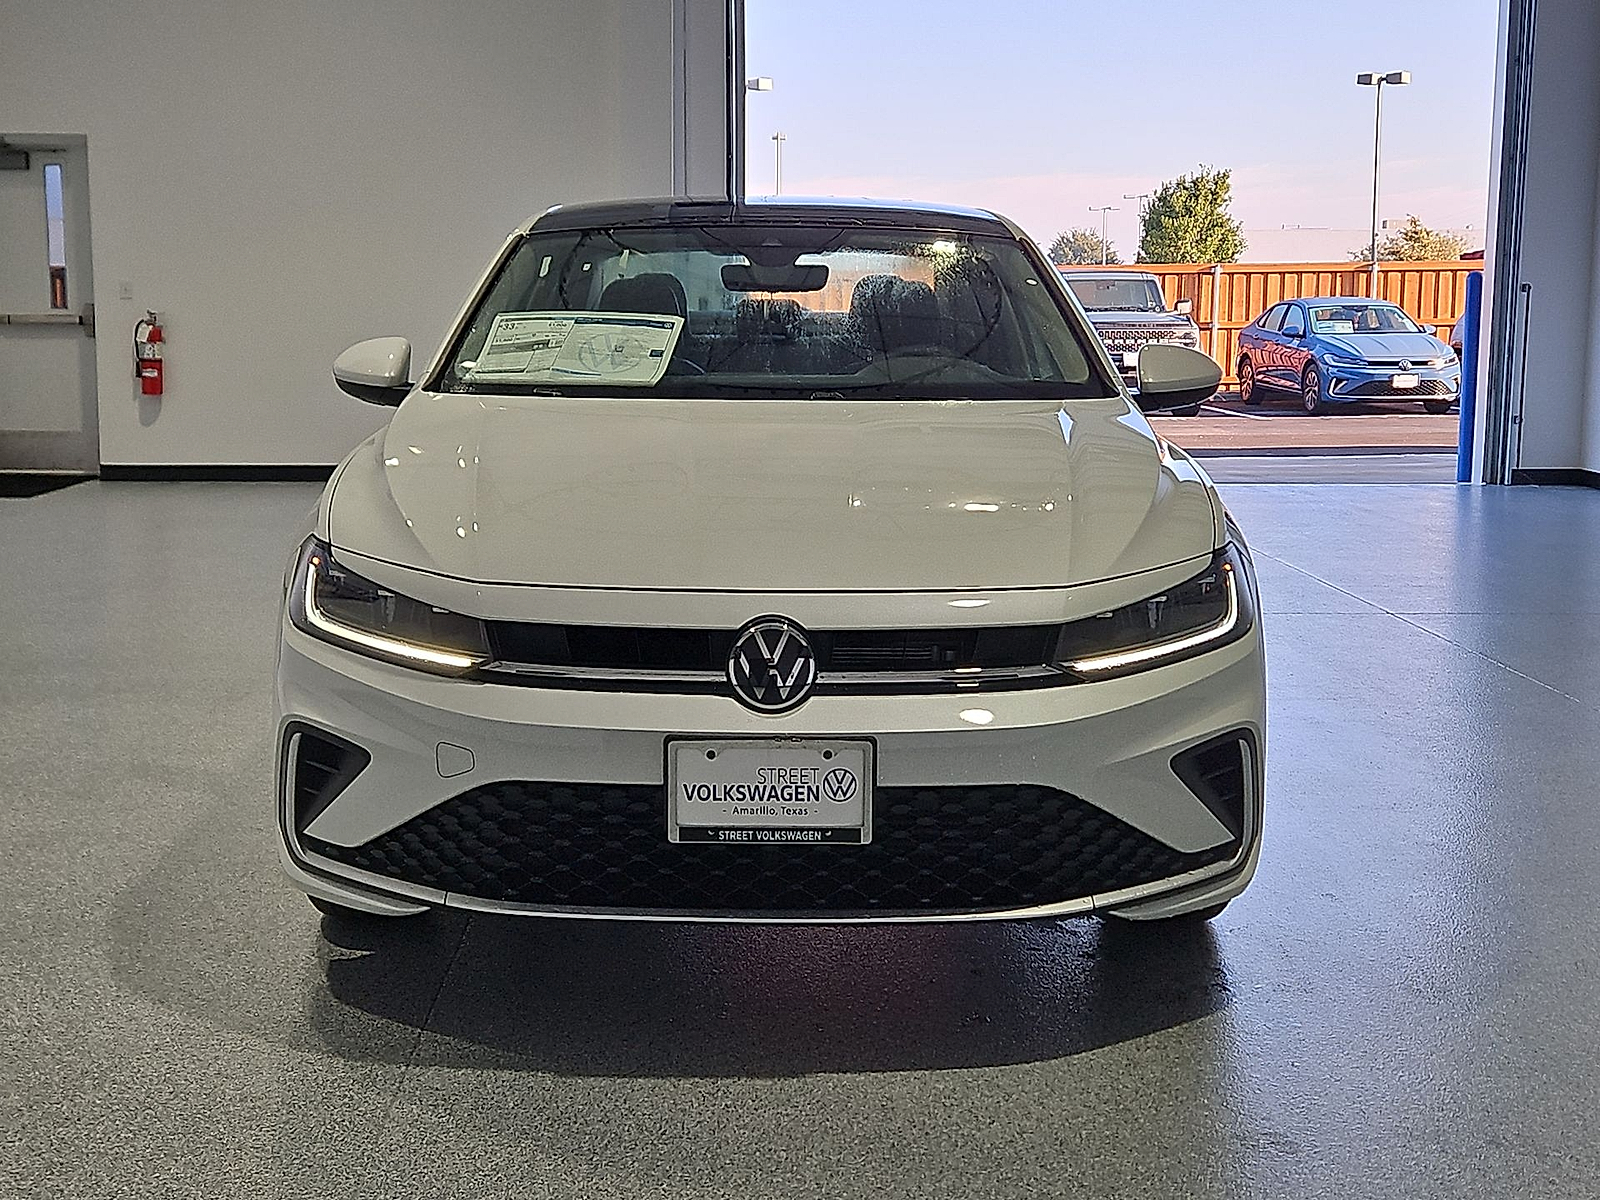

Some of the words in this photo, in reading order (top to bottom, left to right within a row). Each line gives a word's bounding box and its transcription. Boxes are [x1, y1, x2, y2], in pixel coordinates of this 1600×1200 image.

[757, 767, 820, 784] STREET
[683, 784, 820, 802] VOLKSWAGEN
[732, 806, 778, 816] Amarillo,
[781, 806, 808, 816] Texas
[718, 831, 753, 840] STREET
[756, 831, 821, 841] VOLKSWAGEN
